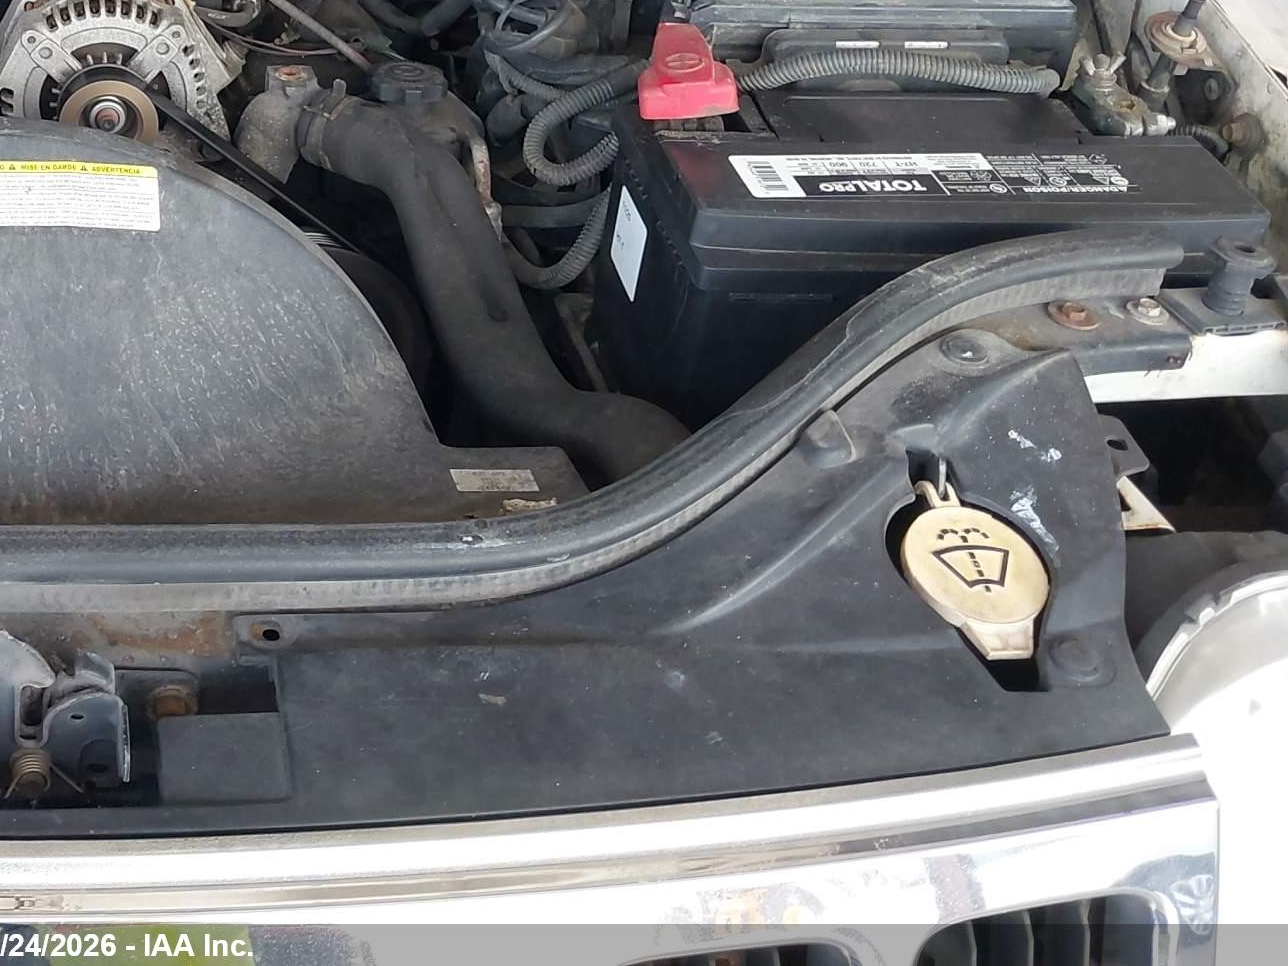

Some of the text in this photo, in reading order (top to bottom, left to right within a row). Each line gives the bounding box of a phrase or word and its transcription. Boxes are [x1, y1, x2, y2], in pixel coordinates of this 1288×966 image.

[20, 163, 38, 171] MISE
[40, 163, 51, 171] EN
[91, 166, 141, 174] ADVERTENCIA
[817, 179, 928, 192] TOTALPRO
